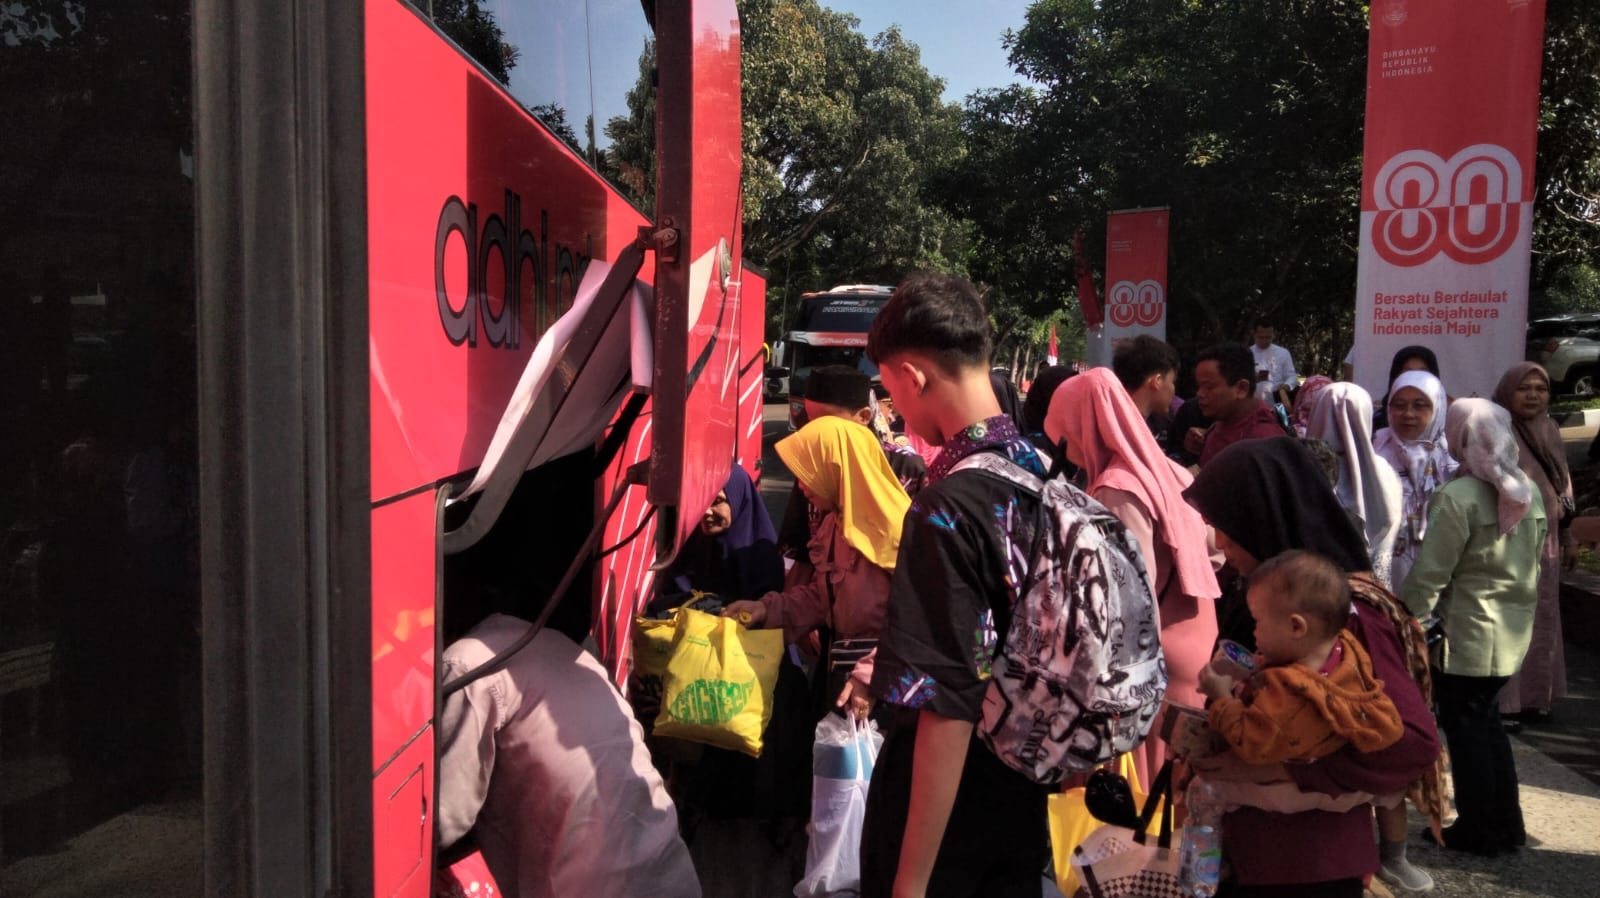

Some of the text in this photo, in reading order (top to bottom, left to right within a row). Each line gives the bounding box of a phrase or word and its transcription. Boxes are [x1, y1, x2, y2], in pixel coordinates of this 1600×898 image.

[1382, 57, 1428, 69] REPUBLIK
[1382, 66, 1433, 78] INDONESIA
[1372, 144, 1522, 267] 80
[434, 187, 548, 349] adhi
[1110, 280, 1164, 327] 80
[1374, 290, 1508, 305] Bersatu Berdaulat
[1374, 306, 1499, 322] Rakyat Sejahtera
[1373, 321, 1481, 337] Indonesia Maju
